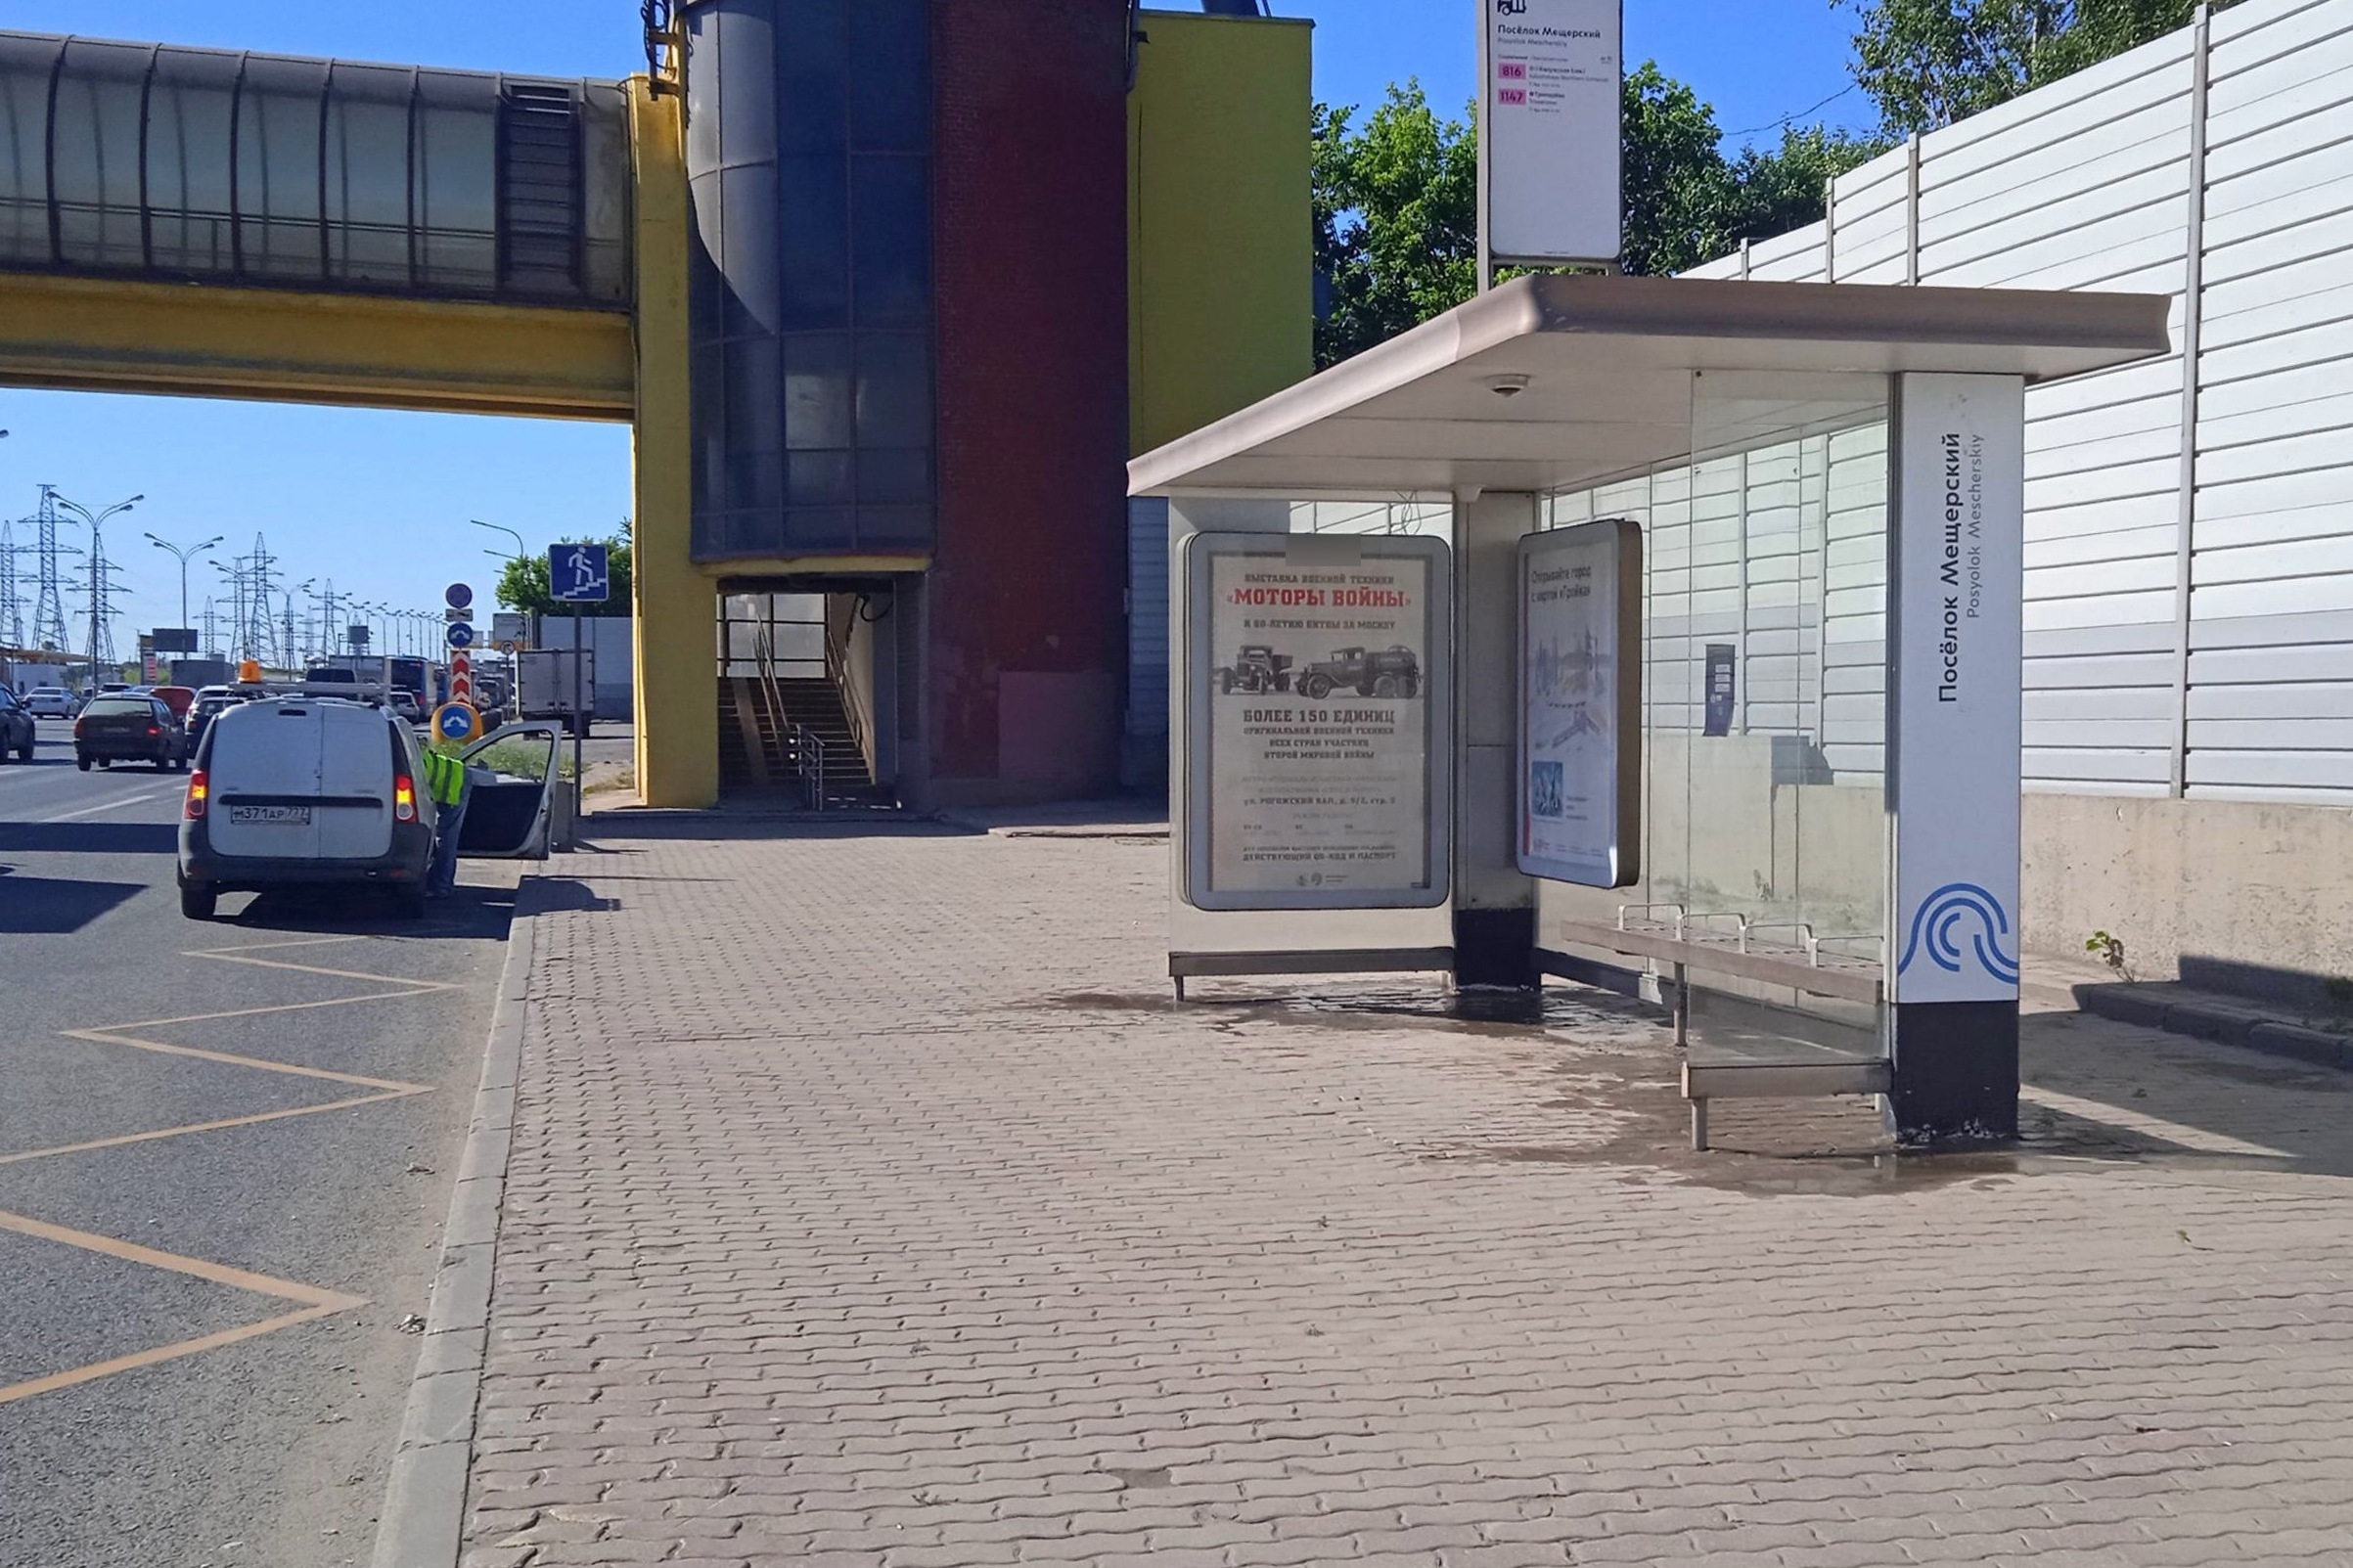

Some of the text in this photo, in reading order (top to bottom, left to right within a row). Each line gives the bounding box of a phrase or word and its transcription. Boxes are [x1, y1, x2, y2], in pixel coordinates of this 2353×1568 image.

[1497, 23, 1602, 39] Посёлок Мещерский
[1502, 66, 1522, 76] 816
[1500, 91, 1523, 103] 1147
[1967, 434, 1985, 619] Posyolok Mescherskiy
[1938, 433, 1964, 703] Посёлок Мещерский
[1244, 573, 1395, 585] ВЫСТАВКА ВОЕННОЙ ТЕХНИКИ
[1227, 586, 1411, 607] «МОТОРЫ ВОЙНЫ»
[1244, 619, 1251, 629] К
[1342, 620, 1356, 629] ЗА
[1357, 620, 1396, 630] МОСКВУ
[1243, 709, 1395, 725] БОЛЕЕ 150 ЕДИНИЦ
[1269, 739, 1292, 747] ВСЕХ
[1292, 739, 1321, 747] СТРАН
[1263, 749, 1375, 759] ВТОРОЙ МИРОВОЙ ВОЙНЫ
[1243, 852, 1312, 862] ДЕЙСТВУЮЩИЙ
[1357, 852, 1396, 861] ПАСПОРТ
